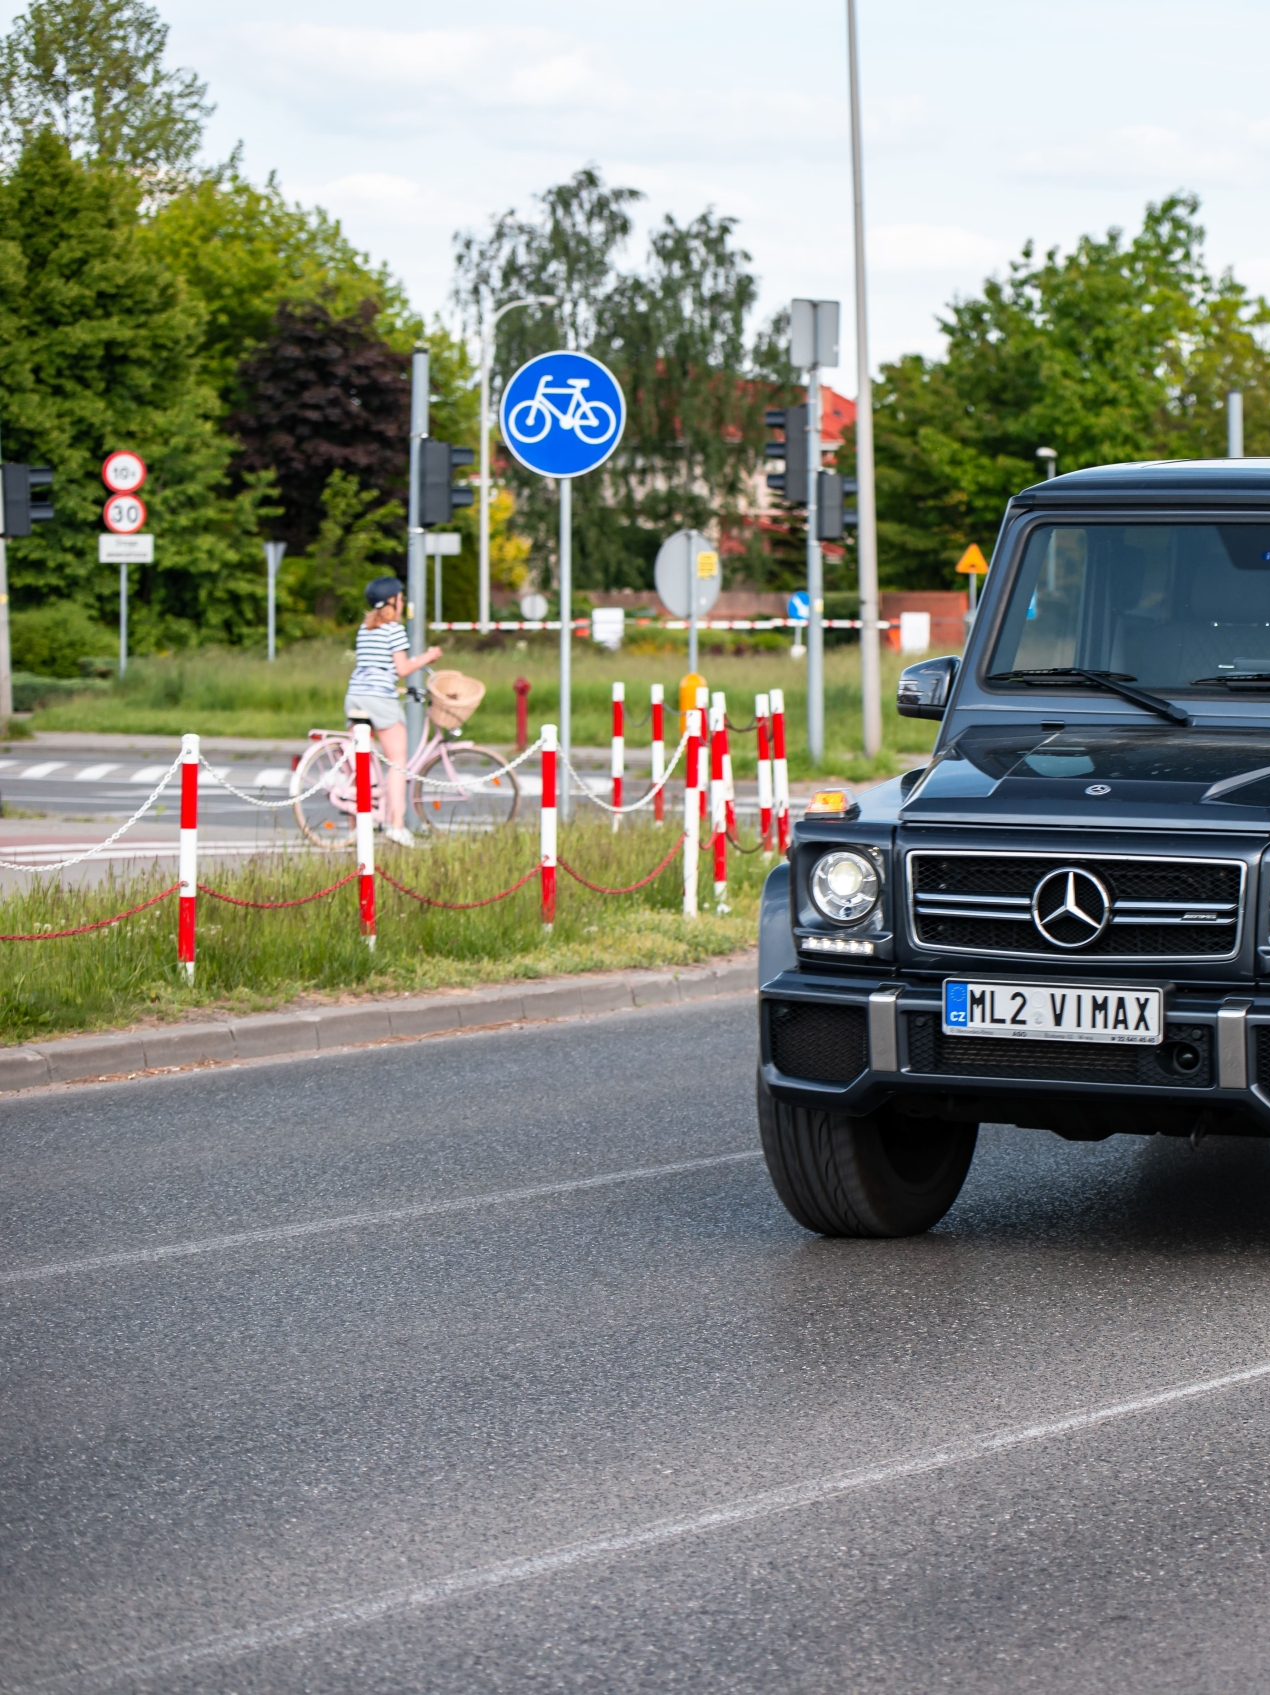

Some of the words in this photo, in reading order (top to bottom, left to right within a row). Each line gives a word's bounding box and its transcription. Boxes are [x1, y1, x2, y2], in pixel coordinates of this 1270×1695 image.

[110, 505, 139, 523] 30
[949, 1010, 966, 1022] CZ
[969, 989, 1028, 1025] ML2
[1050, 993, 1152, 1032] VIMAX
